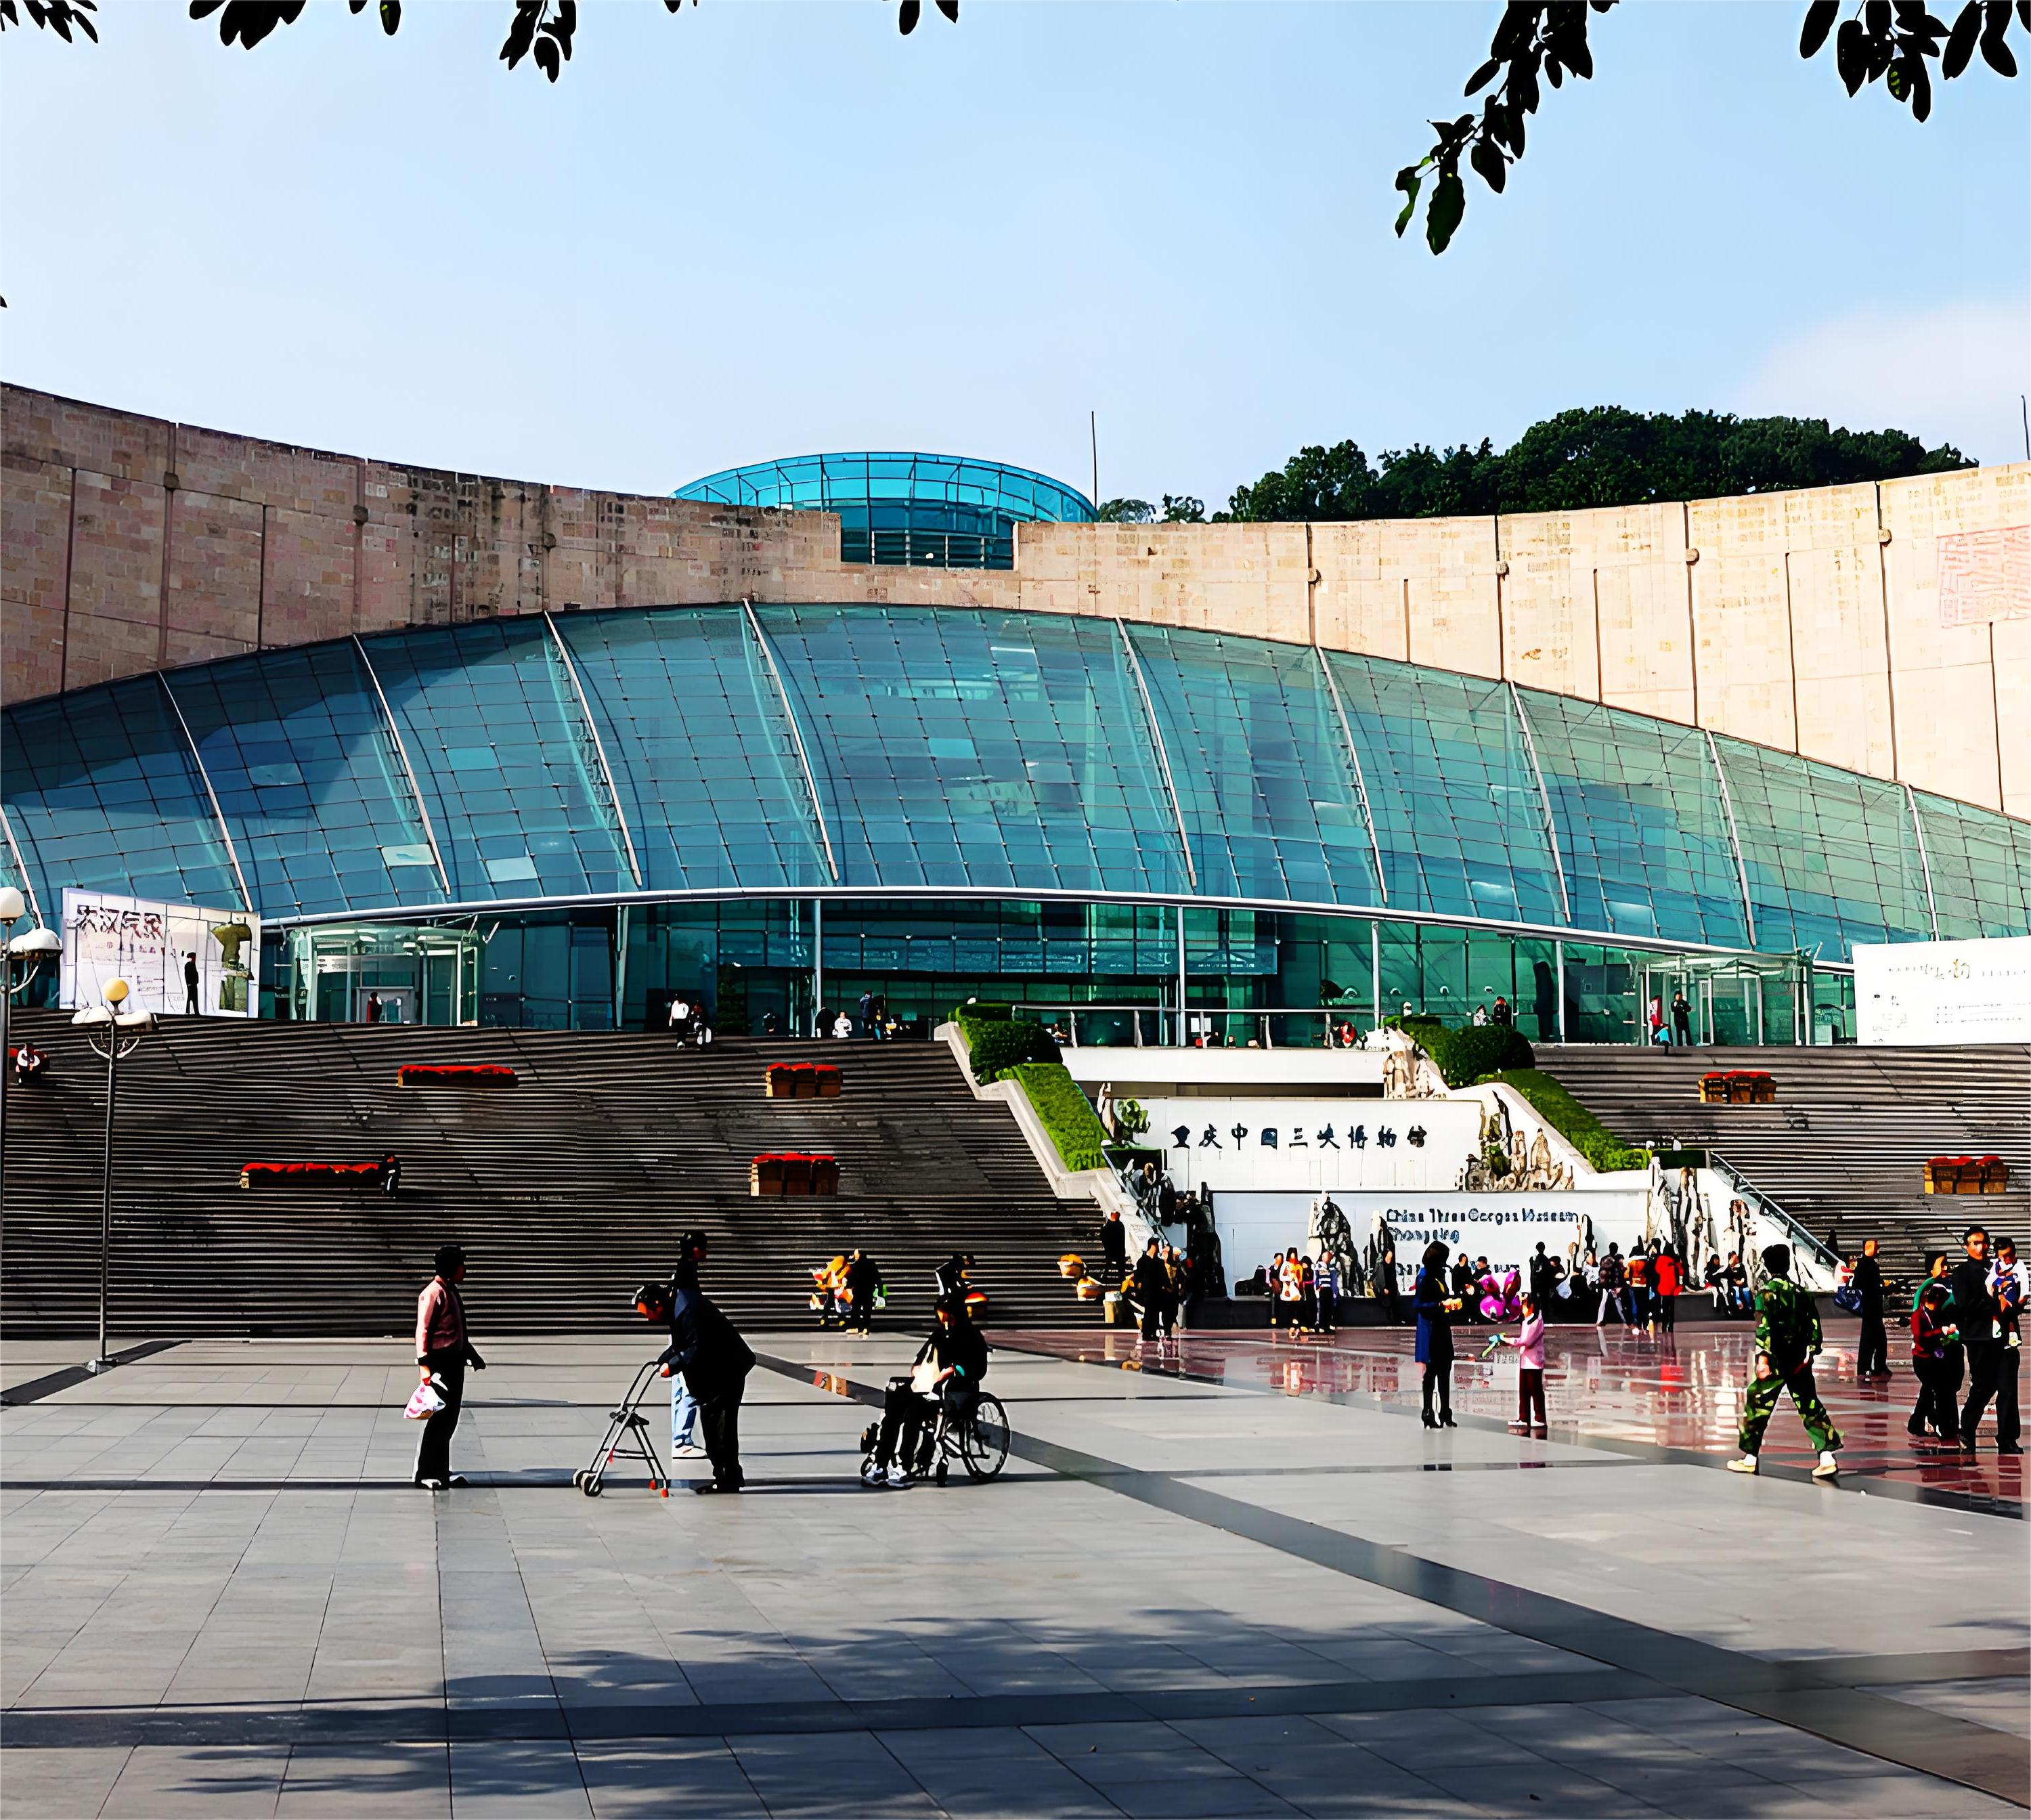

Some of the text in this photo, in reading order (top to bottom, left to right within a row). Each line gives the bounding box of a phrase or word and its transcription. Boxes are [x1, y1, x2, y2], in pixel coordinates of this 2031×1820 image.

[1386, 1209, 1424, 1222] China
[1468, 1208, 1519, 1226] Gorges
[1522, 1208, 1578, 1223] Museum
